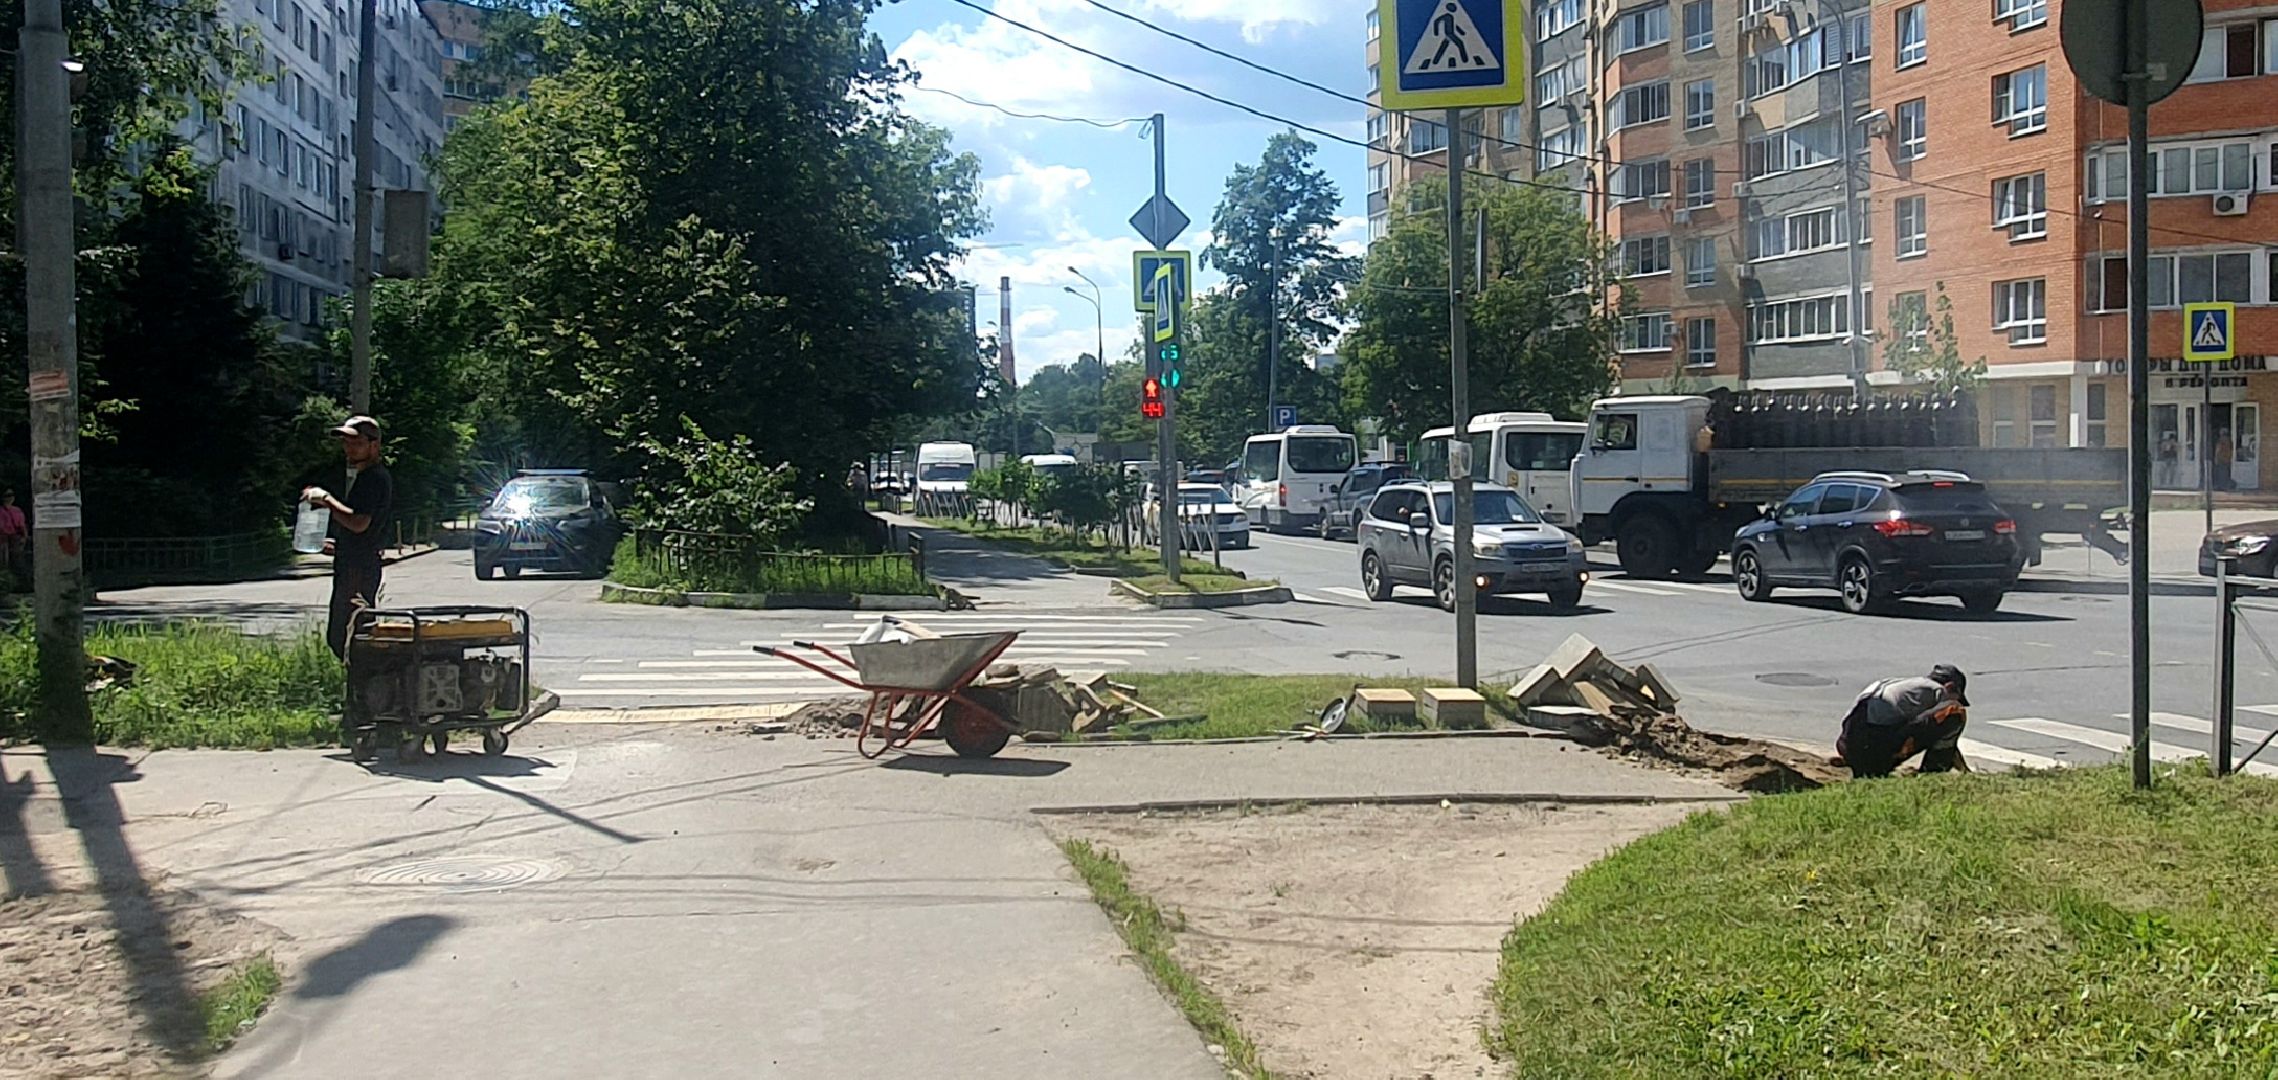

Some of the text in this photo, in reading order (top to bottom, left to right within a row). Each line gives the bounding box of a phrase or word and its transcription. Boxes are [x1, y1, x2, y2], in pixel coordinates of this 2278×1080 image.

[2106, 354, 2267, 373] ТОРЫ ДЛ ДОМА
[1143, 401, 1163, 417] 44
[1279, 408, 1291, 425] P
